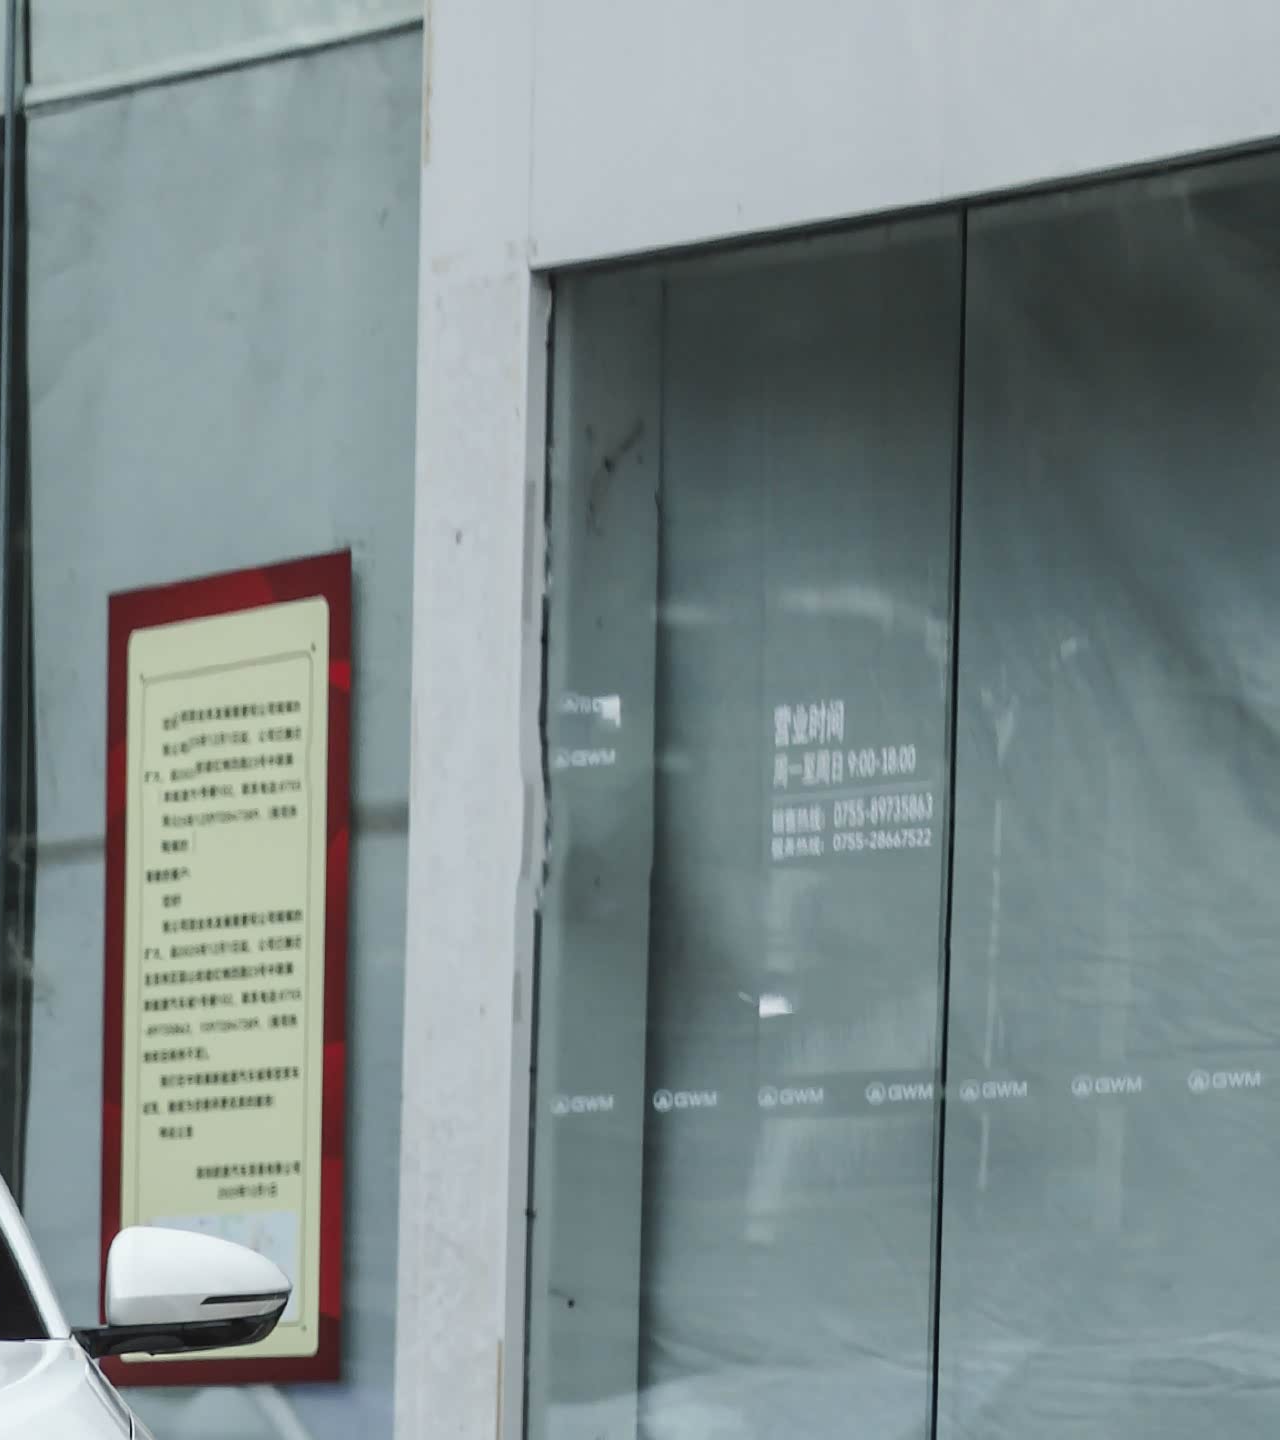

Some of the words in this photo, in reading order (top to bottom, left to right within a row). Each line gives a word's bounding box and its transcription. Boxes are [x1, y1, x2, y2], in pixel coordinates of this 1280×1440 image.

[774, 699, 844, 746] 营业时间
[1095, 1075, 1142, 1094] GWM
[1212, 1070, 1261, 1088] GWM
[780, 1087, 824, 1106] GWM
[888, 1083, 934, 1101] GWM
[982, 1080, 1028, 1099] GWM
[571, 1094, 614, 1112] GWM
[674, 1090, 717, 1109] GWM
